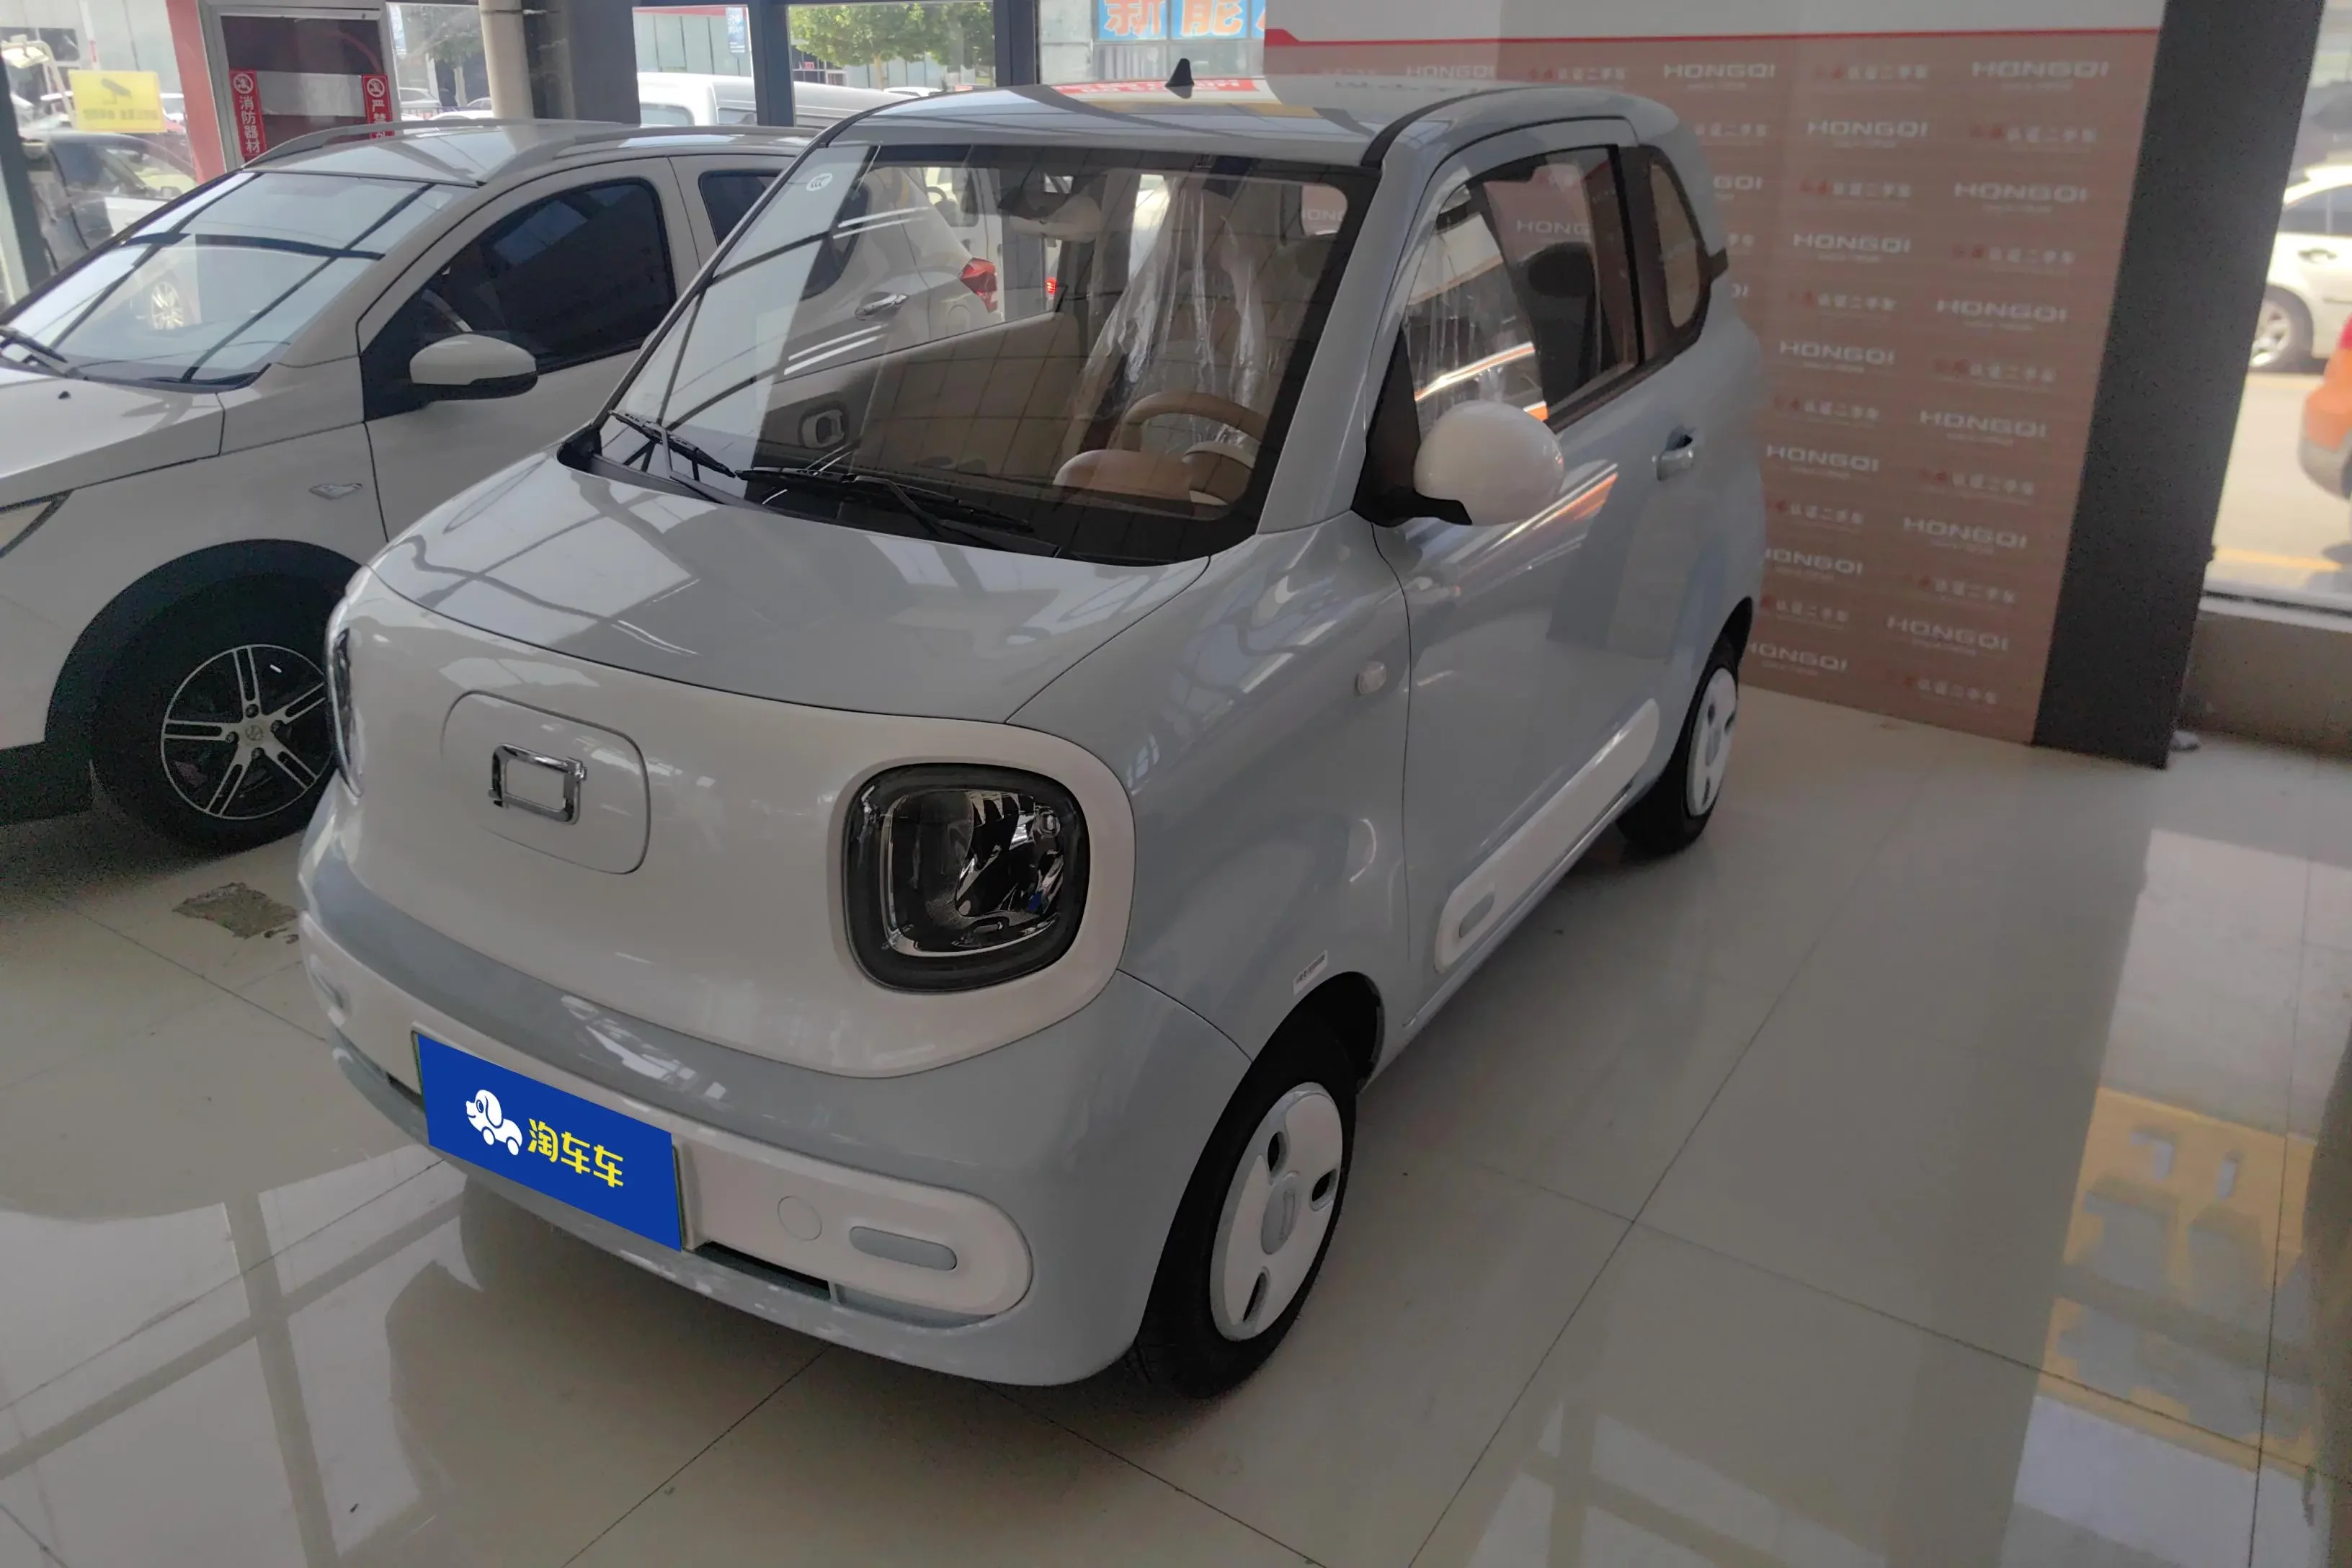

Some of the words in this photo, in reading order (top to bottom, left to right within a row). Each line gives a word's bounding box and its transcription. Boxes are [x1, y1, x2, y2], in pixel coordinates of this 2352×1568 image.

[1104, 0, 1266, 35] 新能
[239, 95, 260, 153] 消防器材
